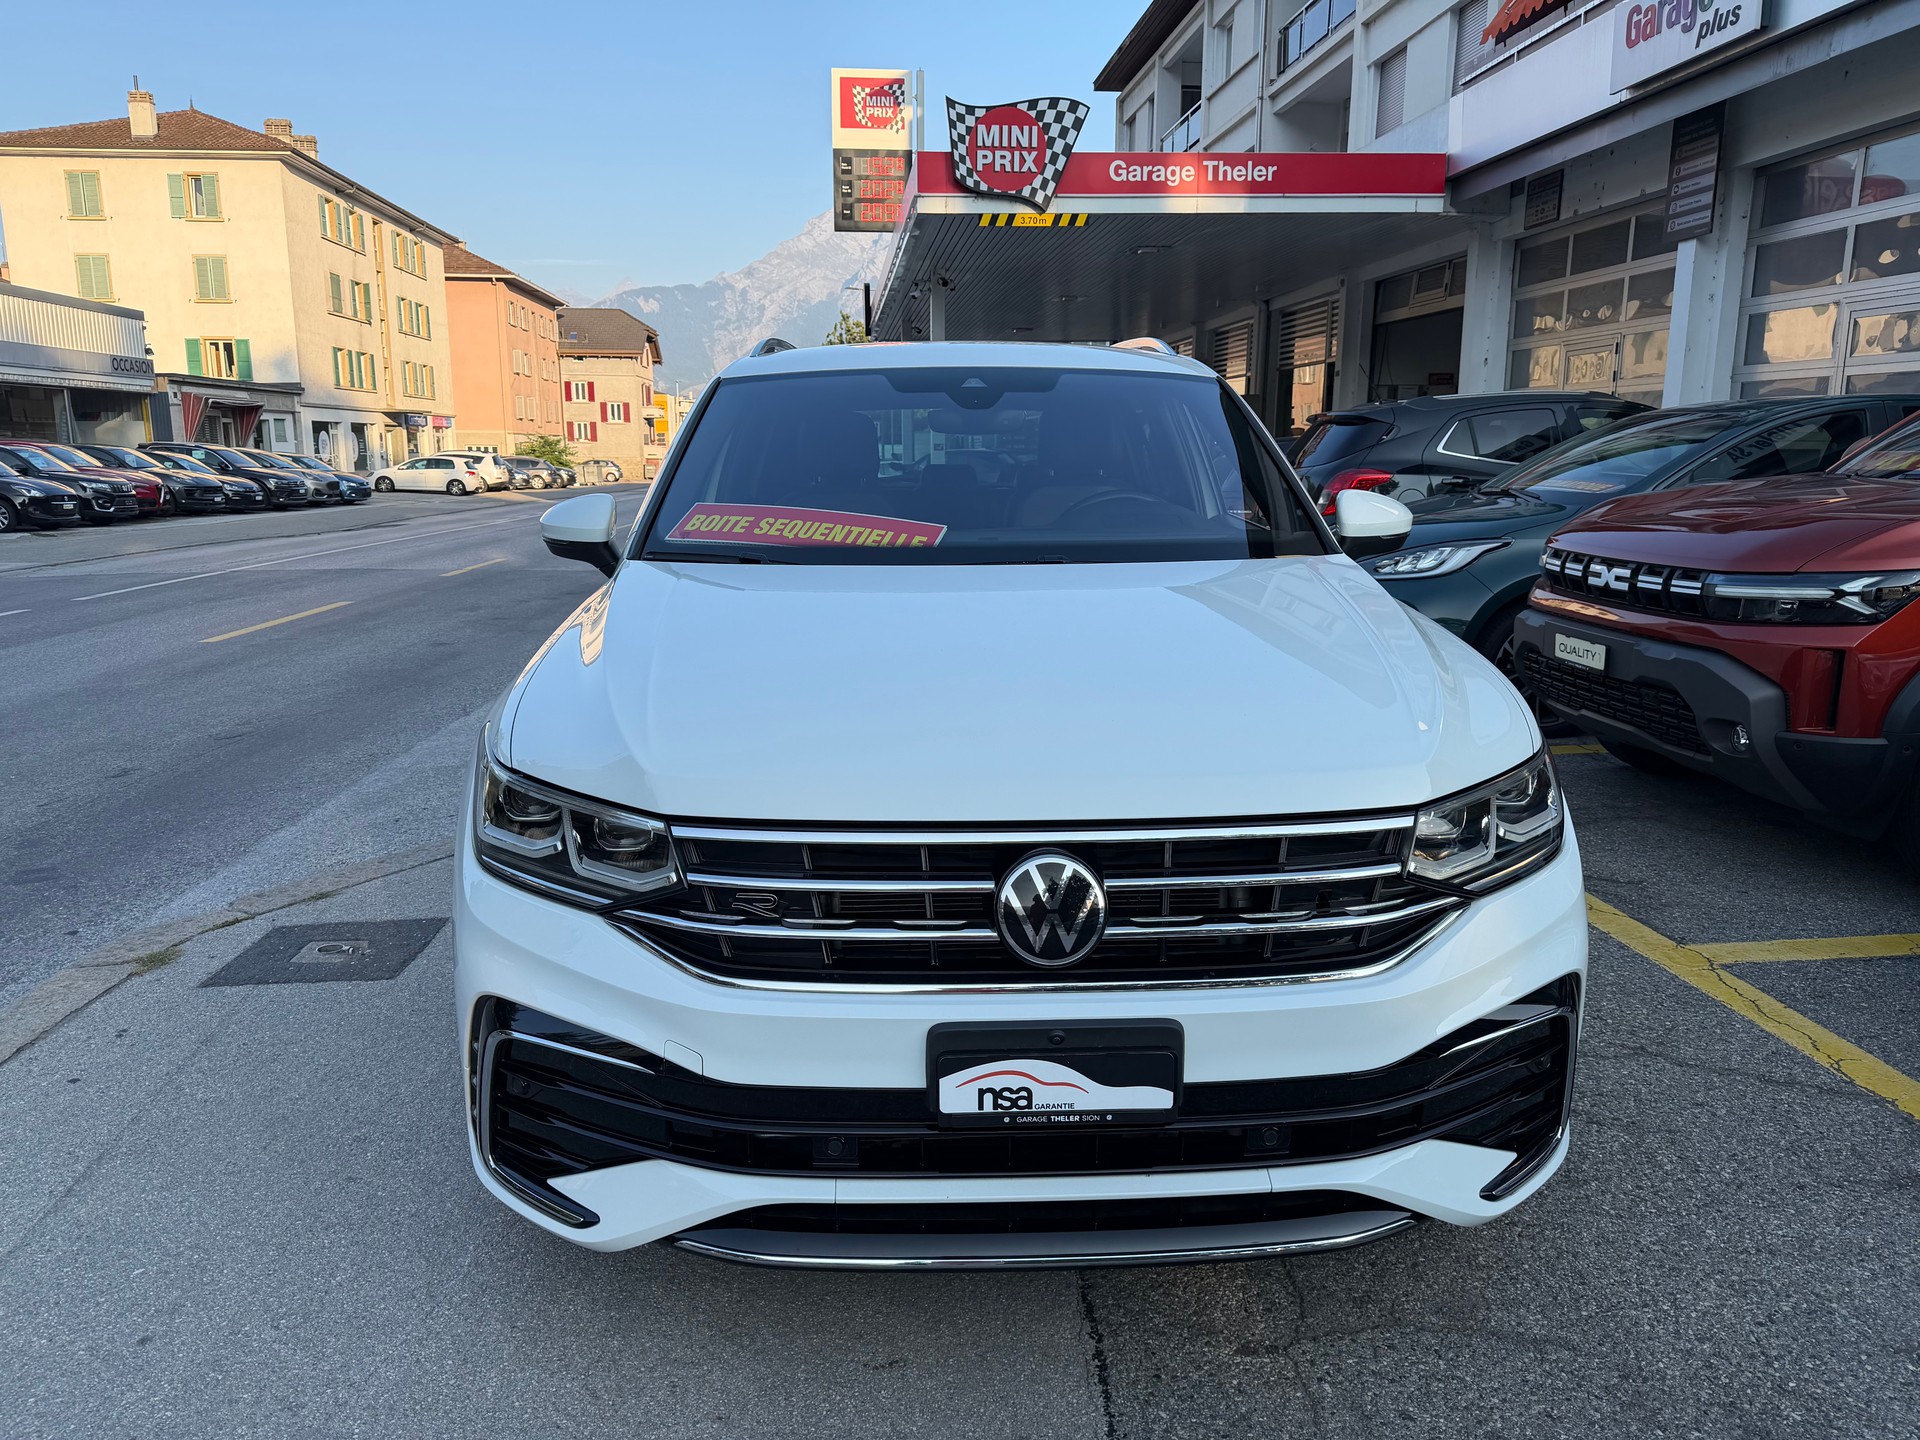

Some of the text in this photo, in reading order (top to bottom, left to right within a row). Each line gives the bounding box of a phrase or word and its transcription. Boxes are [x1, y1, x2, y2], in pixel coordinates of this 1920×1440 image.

[1695, 4, 1742, 50] plus
[866, 96, 893, 107] MINI
[866, 107, 894, 118] PRIX
[976, 124, 1038, 148] MINI
[976, 150, 1038, 173] PRIX
[1108, 159, 1278, 187] Garage Theler
[111, 357, 154, 374] OCCASION
[684, 514, 755, 534] BOITE
[977, 1086, 1034, 1112] nsa
[1034, 1102, 1076, 1110] GARANTIE
[1016, 1114, 1101, 1123] GARAGE THELER SION
